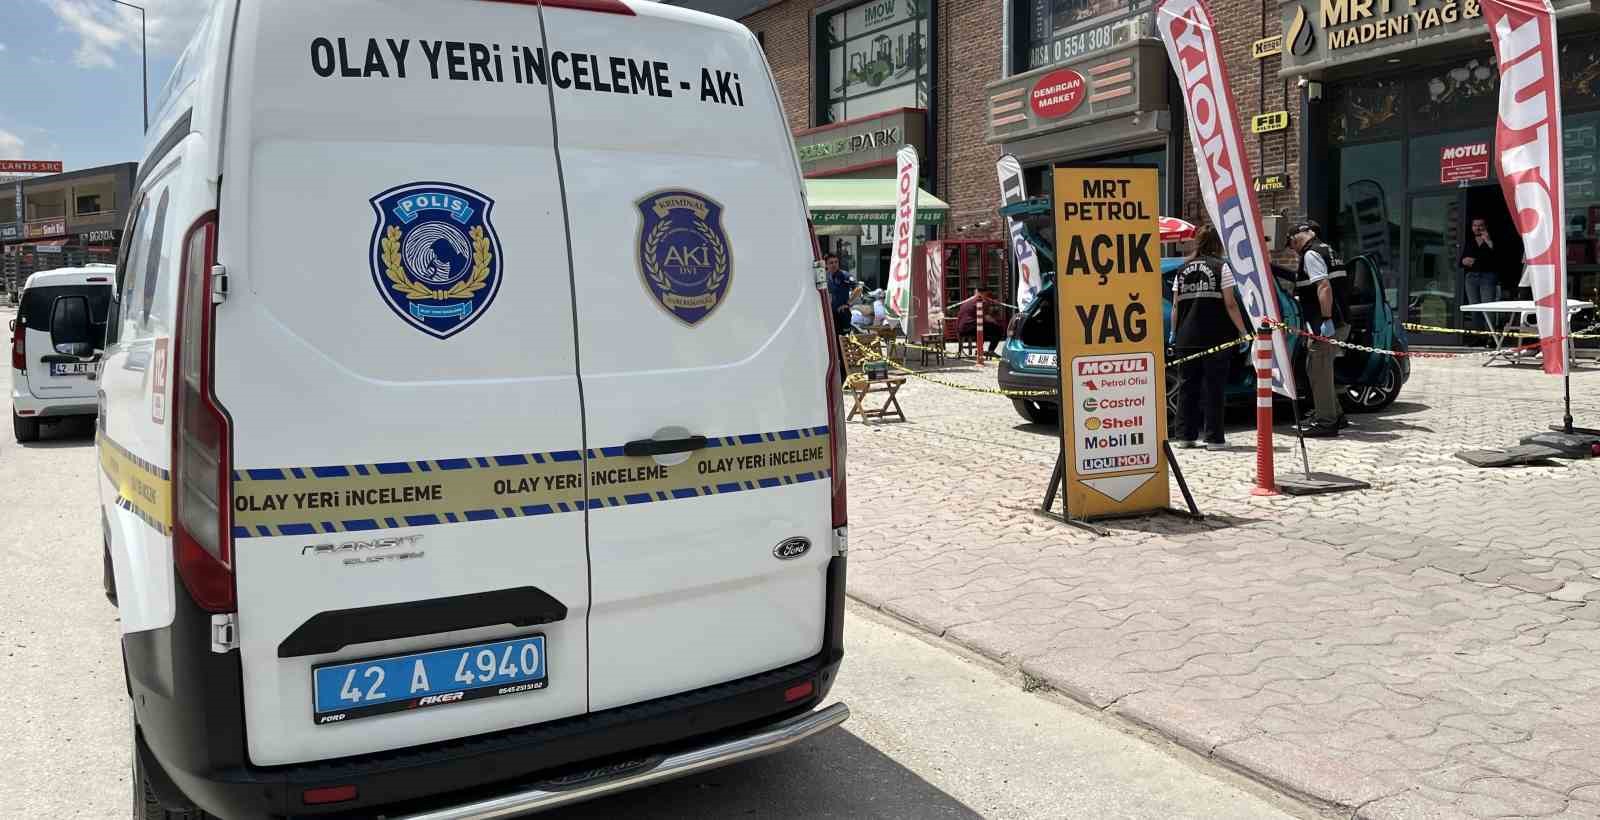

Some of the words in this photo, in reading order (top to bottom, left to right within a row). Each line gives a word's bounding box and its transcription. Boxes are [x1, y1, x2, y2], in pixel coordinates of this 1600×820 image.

[1463, 0, 1480, 19] &
[1054, 41, 1062, 61] 0
[1064, 33, 1085, 57] 554
[1089, 25, 1110, 50] 308
[311, 37, 409, 79] OLAY
[1038, 92, 1075, 108] MARKET
[851, 128, 897, 151] PARK
[1443, 144, 1488, 161] MOTUL
[1083, 180, 1130, 198] MRT
[1064, 201, 1150, 221] PETROL
[1066, 233, 1154, 286] AÇIK
[1075, 292, 1147, 345] YAĞ
[1081, 359, 1146, 375] MOTUL
[1101, 378, 1126, 388] Petrol
[1128, 376, 1148, 386] Ofisi
[1100, 396, 1145, 409] Castrol
[1102, 415, 1143, 430] Shell
[1085, 432, 1127, 449] Mobil
[697, 457, 735, 475] OLAY
[1083, 456, 1116, 470] LIQUI
[1118, 454, 1150, 466] MOLY
[494, 477, 539, 496] OLAY
[235, 494, 288, 512] OLAY
[340, 665, 387, 703] 42
[410, 659, 431, 694] A
[454, 643, 540, 685] 4940
[320, 713, 346, 723] FORD
